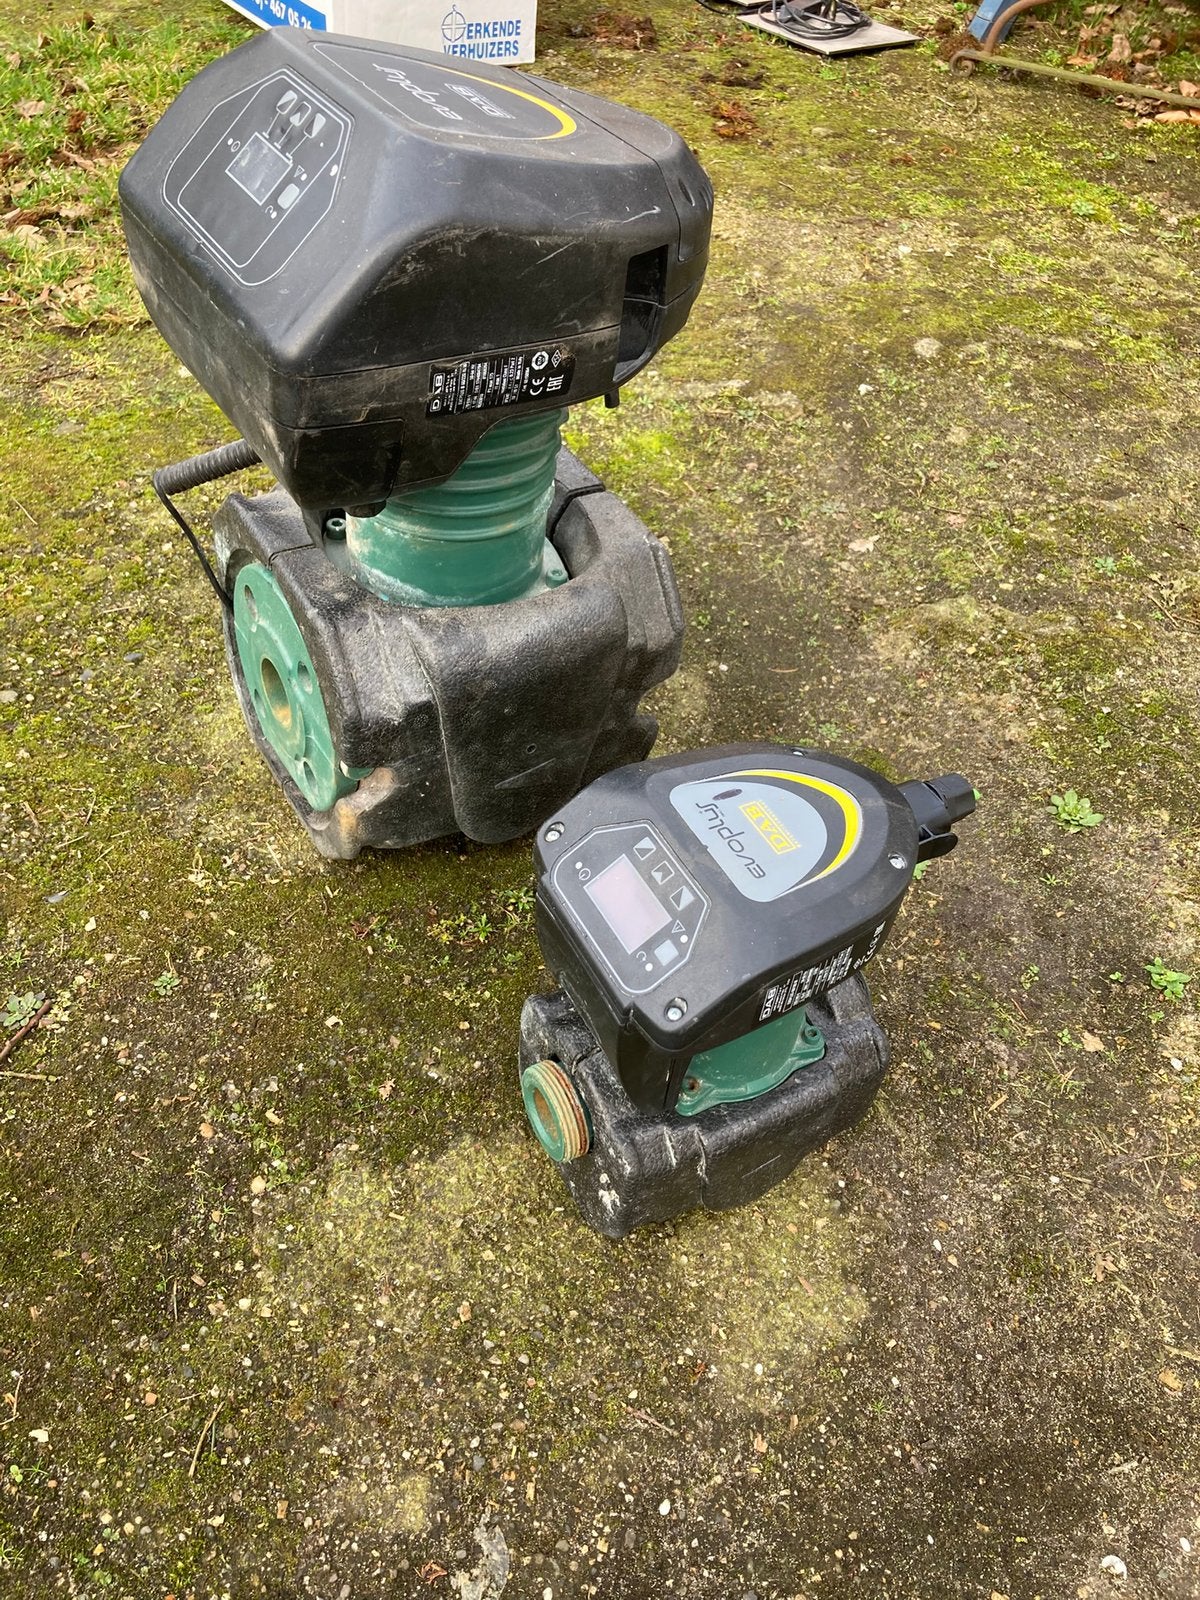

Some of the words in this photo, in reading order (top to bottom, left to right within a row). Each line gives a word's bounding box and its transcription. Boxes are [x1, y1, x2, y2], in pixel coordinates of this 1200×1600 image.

[466, 19, 521, 40] ERKENDE
[443, 40, 519, 59] VERHUIZERS
[695, 802, 766, 879] evoplus
[745, 804, 789, 850] DAB
